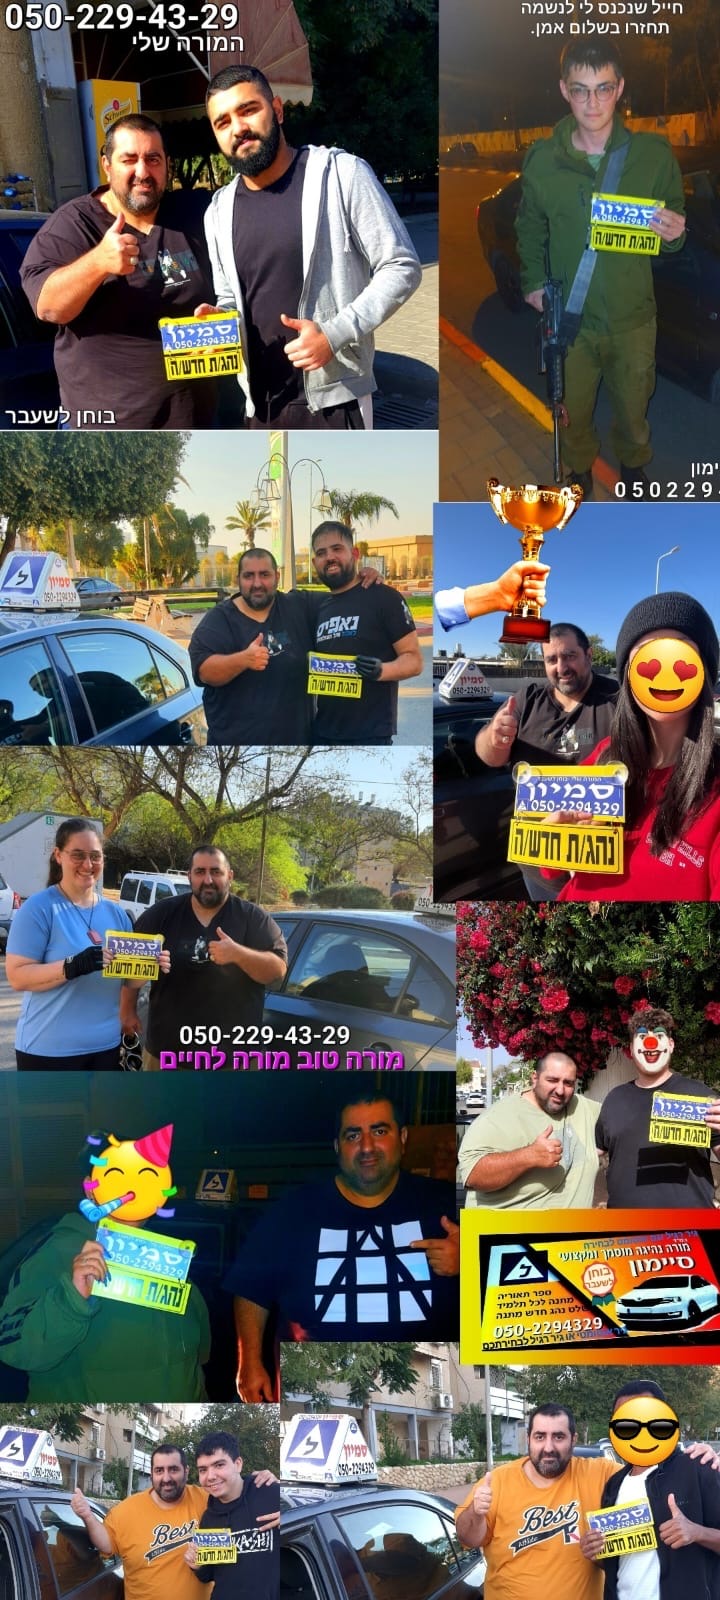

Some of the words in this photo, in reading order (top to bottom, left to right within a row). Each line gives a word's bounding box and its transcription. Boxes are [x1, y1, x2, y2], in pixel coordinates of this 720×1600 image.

[595, 231, 626, 248] חדש/ה
[628, 235, 656, 250] נהג/ת
[167, 324, 233, 344] סמיון
[174, 334, 238, 349] 050-2294329
[170, 358, 206, 376] חדש/ה
[209, 354, 239, 373] נהג/ת
[311, 679, 336, 692] חדש/ה
[337, 681, 358, 694] נהג/ת
[526, 782, 615, 801] סמיון
[530, 800, 620, 815] 050-2294329
[514, 828, 561, 861] חדש/ה
[566, 833, 615, 866] נהג/ת
[112, 939, 159, 950] סמיון
[107, 961, 133, 975] חדש/ה
[134, 963, 156, 977] נהג/ת
[653, 1125, 682, 1142] חדש/ה
[682, 1128, 707, 1144] נהג/ת
[105, 1236, 184, 1265] סמיון
[602, 1246, 634, 1261] מוסמך
[635, 1244, 664, 1256] נהיגה
[665, 1242, 691, 1253] מורה
[559, 1250, 599, 1262] ומקצועי
[110, 1250, 184, 1277] 050-2294329
[629, 1256, 696, 1278] סיימון
[588, 1267, 611, 1281] בוחן
[584, 1277, 614, 1289] לשעבר
[145, 1281, 184, 1308] נהג/ת
[497, 1292, 531, 1300] תאוריה
[532, 1289, 552, 1297] ספר
[496, 1299, 526, 1309] תלמיד
[528, 1297, 546, 1307] לכל
[548, 1296, 574, 1305] מתנה
[495, 1310, 523, 1320] מתנה
[525, 1308, 548, 1317] חדש
[550, 1306, 566, 1315] נהג
[568, 1304, 590, 1313] שלט
[493, 1316, 604, 1339] 050-2294329
[482, 1336, 530, 1350] לבחירתכם
[530, 1335, 550, 1345] רגיל
[552, 1333, 565, 1342] גיר
[565, 1333, 576, 1341] או
[338, 1462, 375, 1476] 050-2294329
[518, 1500, 580, 1535] Best
[591, 1508, 645, 1529] סמיון
[600, 1516, 650, 1533] 050-2294329
[150, 1519, 197, 1547] Best
[627, 1532, 653, 1550] נהג/ת
